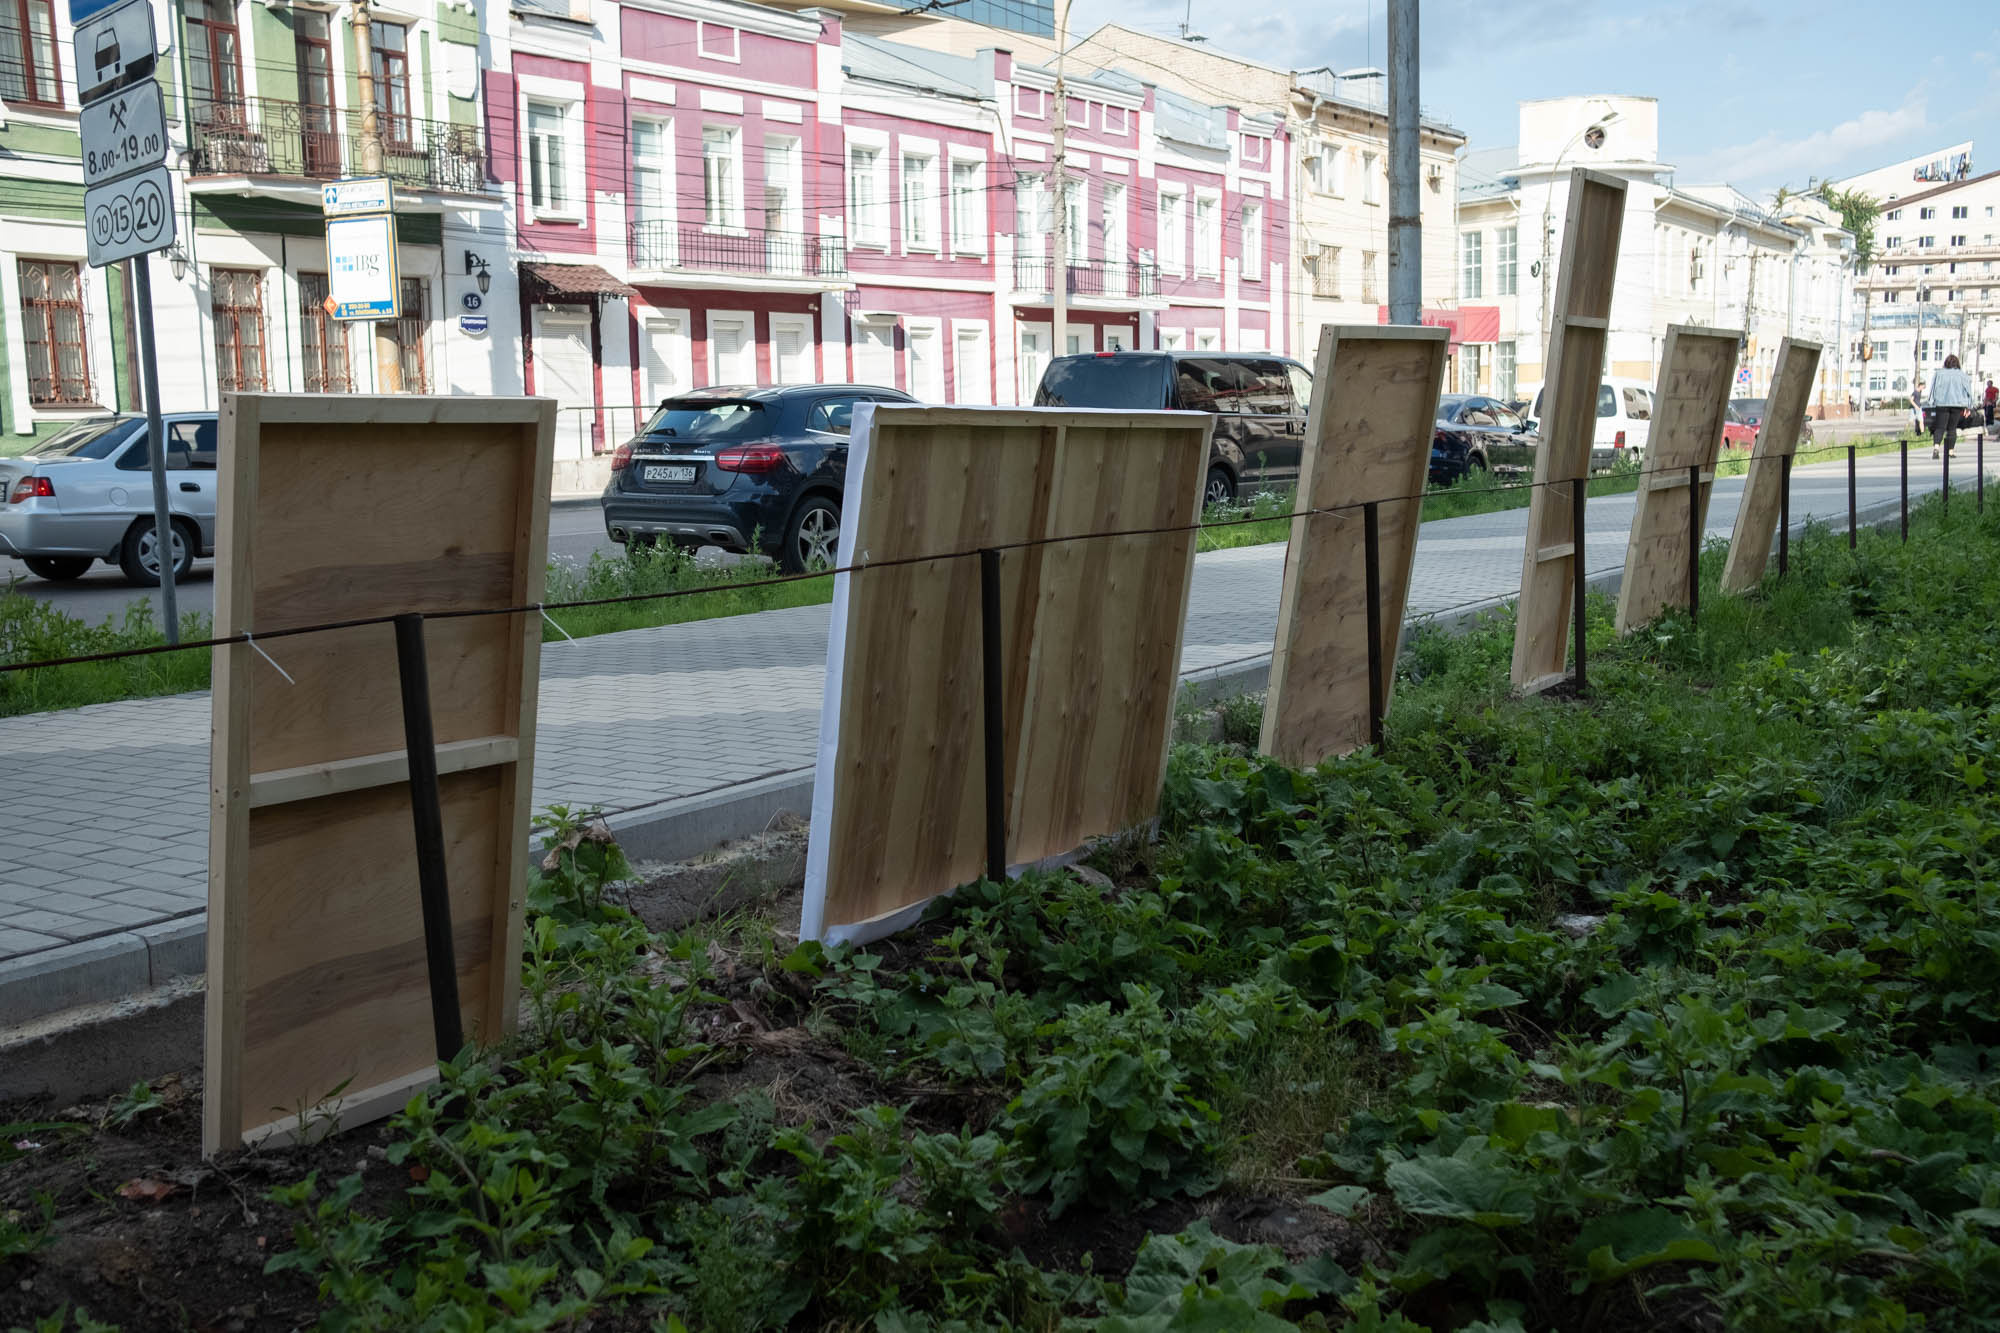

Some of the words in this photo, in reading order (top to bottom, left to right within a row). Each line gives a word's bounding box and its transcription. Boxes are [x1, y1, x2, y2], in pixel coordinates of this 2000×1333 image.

[88, 133, 159, 175] 8.00-19.00
[97, 214, 109, 236] 10
[113, 206, 129, 233] 15
[135, 192, 160, 231] 20
[467, 296, 479, 307] 16
